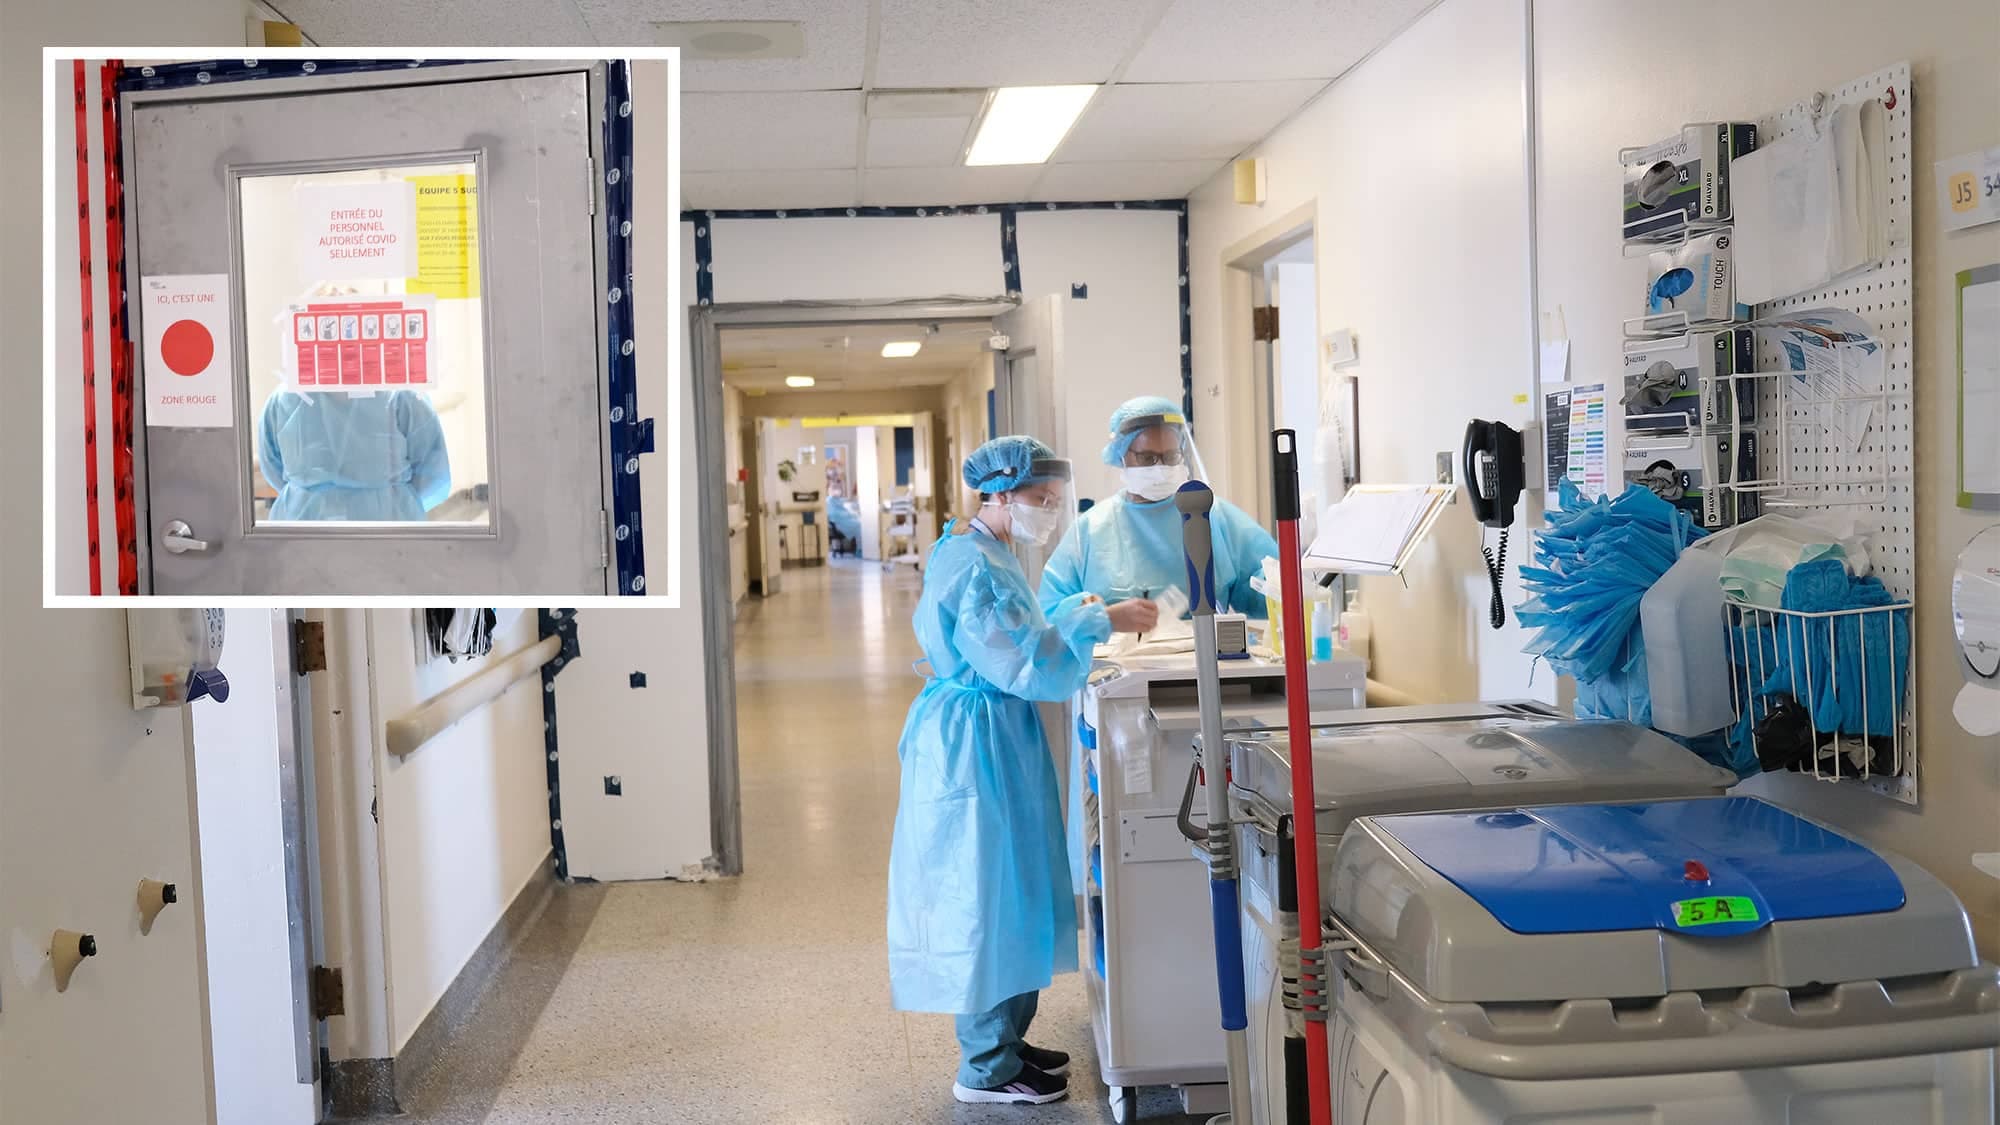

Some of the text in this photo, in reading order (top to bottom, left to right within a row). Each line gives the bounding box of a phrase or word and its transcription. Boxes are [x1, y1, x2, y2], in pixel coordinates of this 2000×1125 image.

[1679, 169, 1688, 183] XL
[1956, 181, 1972, 204] J5
[330, 208, 383, 220] ENTRÉE DU
[330, 221, 384, 232] PERSONNEL
[319, 233, 397, 246] AUTORISÉ COVID
[329, 247, 385, 259] SEULEMENT
[197, 293, 215, 303] UNE
[1680, 374, 1687, 387] M
[161, 395, 216, 405] ZONE ROUGE
[1690, 899, 1733, 921] 5 A
